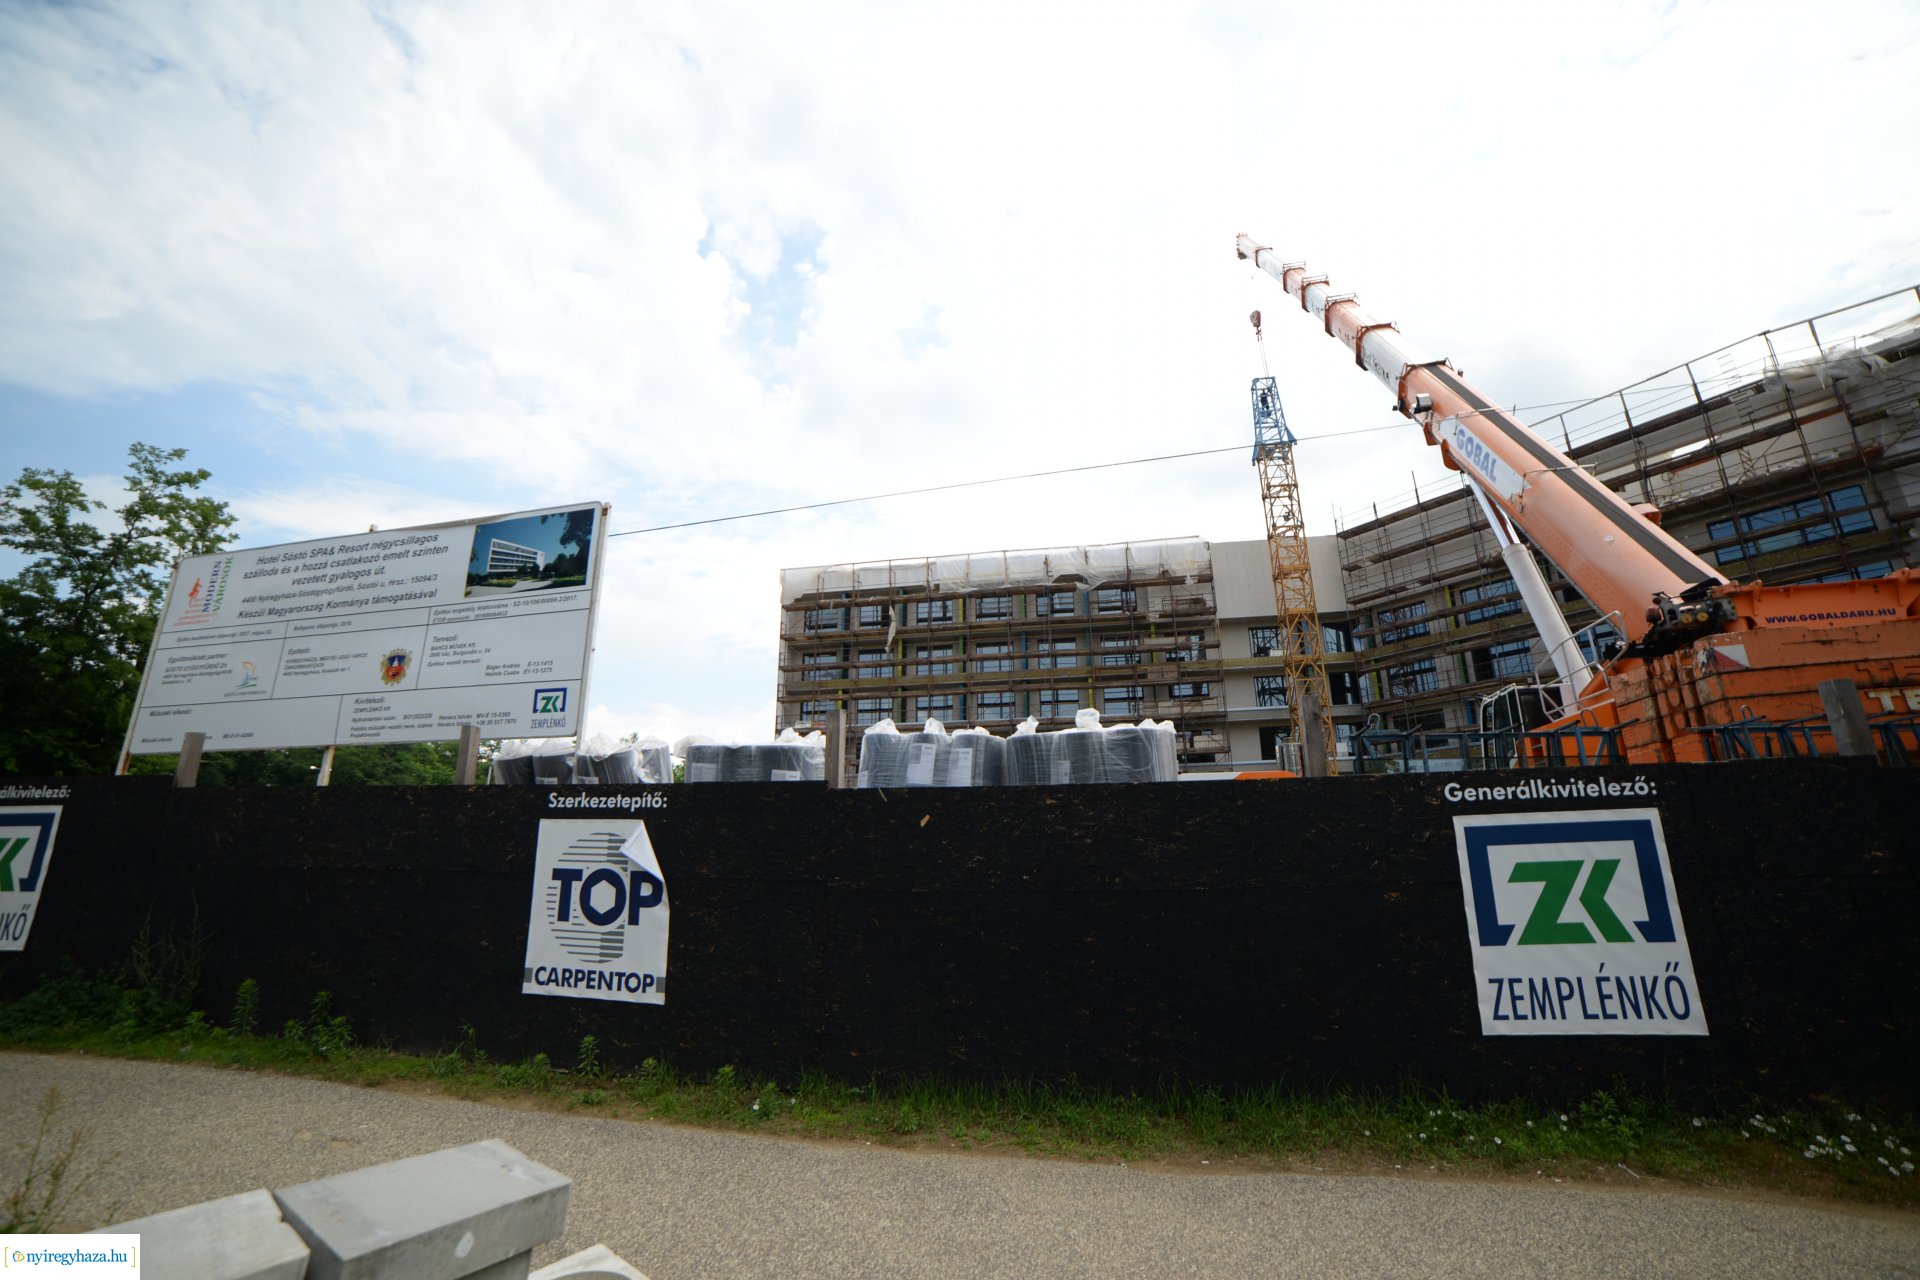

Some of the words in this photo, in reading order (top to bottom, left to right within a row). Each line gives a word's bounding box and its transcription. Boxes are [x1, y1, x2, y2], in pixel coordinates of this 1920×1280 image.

[1456, 428, 1497, 483] GOBAL
[256, 553, 280, 565] Hotel
[337, 541, 369, 554] Resort
[370, 532, 439, 551] négycsillagos
[242, 565, 279, 579] szálloda
[280, 564, 292, 574] és
[300, 559, 328, 571] hozzá
[329, 553, 380, 568] csatlakozó
[382, 549, 409, 561] emelt
[291, 572, 327, 586] vezetett
[327, 567, 372, 583] gyalogos
[237, 607, 266, 619] Készül
[266, 601, 324, 617] Magyarország
[325, 595, 369, 611] Kormánya
[371, 588, 437, 605] támogatásával
[1765, 607, 1897, 624] WWW.GOBALDARU.HU
[530, 715, 566, 728] ZEMPLÉNKŐ
[548, 791, 668, 813] Szerkezetepítő:
[1443, 775, 1659, 804] Generálkivitelező:
[551, 867, 665, 927] TOP
[1507, 858, 1636, 946] ZK
[534, 966, 655, 994] CARPENTOP
[1488, 961, 1691, 1022] ZEMPLÉNKŐ
